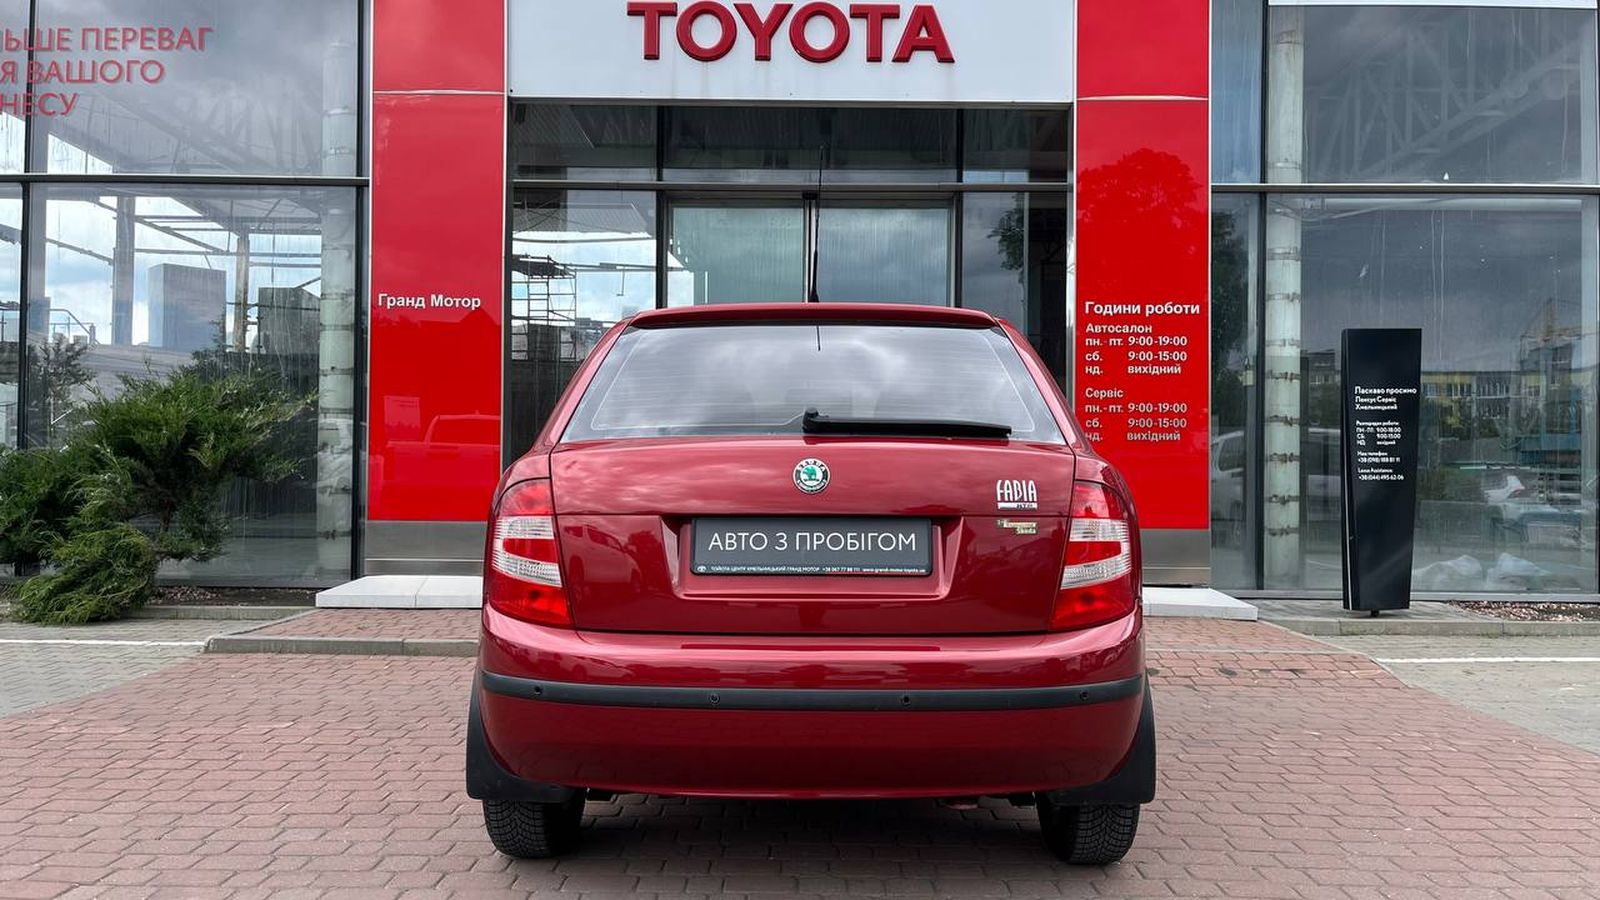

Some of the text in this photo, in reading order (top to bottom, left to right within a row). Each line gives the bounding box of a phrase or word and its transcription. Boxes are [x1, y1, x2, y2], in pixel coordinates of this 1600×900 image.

[627, 1, 955, 63] TOYOTA
[81, 27, 213, 51] ПЕРЕВАГ
[27, 60, 165, 84] ВАШОГО
[378, 293, 481, 310] Гранд Мотор
[1085, 301, 1200, 317] Години роботи
[1086, 323, 1152, 334] Автосалон
[1128, 336, 1187, 346] 9:00-19:00
[1085, 351, 1187, 361] сб. 9:00-15:00
[1085, 364, 1181, 375] нд. вихідний
[1085, 387, 1124, 400] Сервіс
[1128, 403, 1187, 413] 9:00-19:00
[1085, 418, 1187, 428] сб. 9:00-15:00
[1127, 431, 1180, 442] вихідний
[996, 479, 1037, 502] FABIA
[708, 532, 916, 551] АВТО З ПРОБІГОМ
